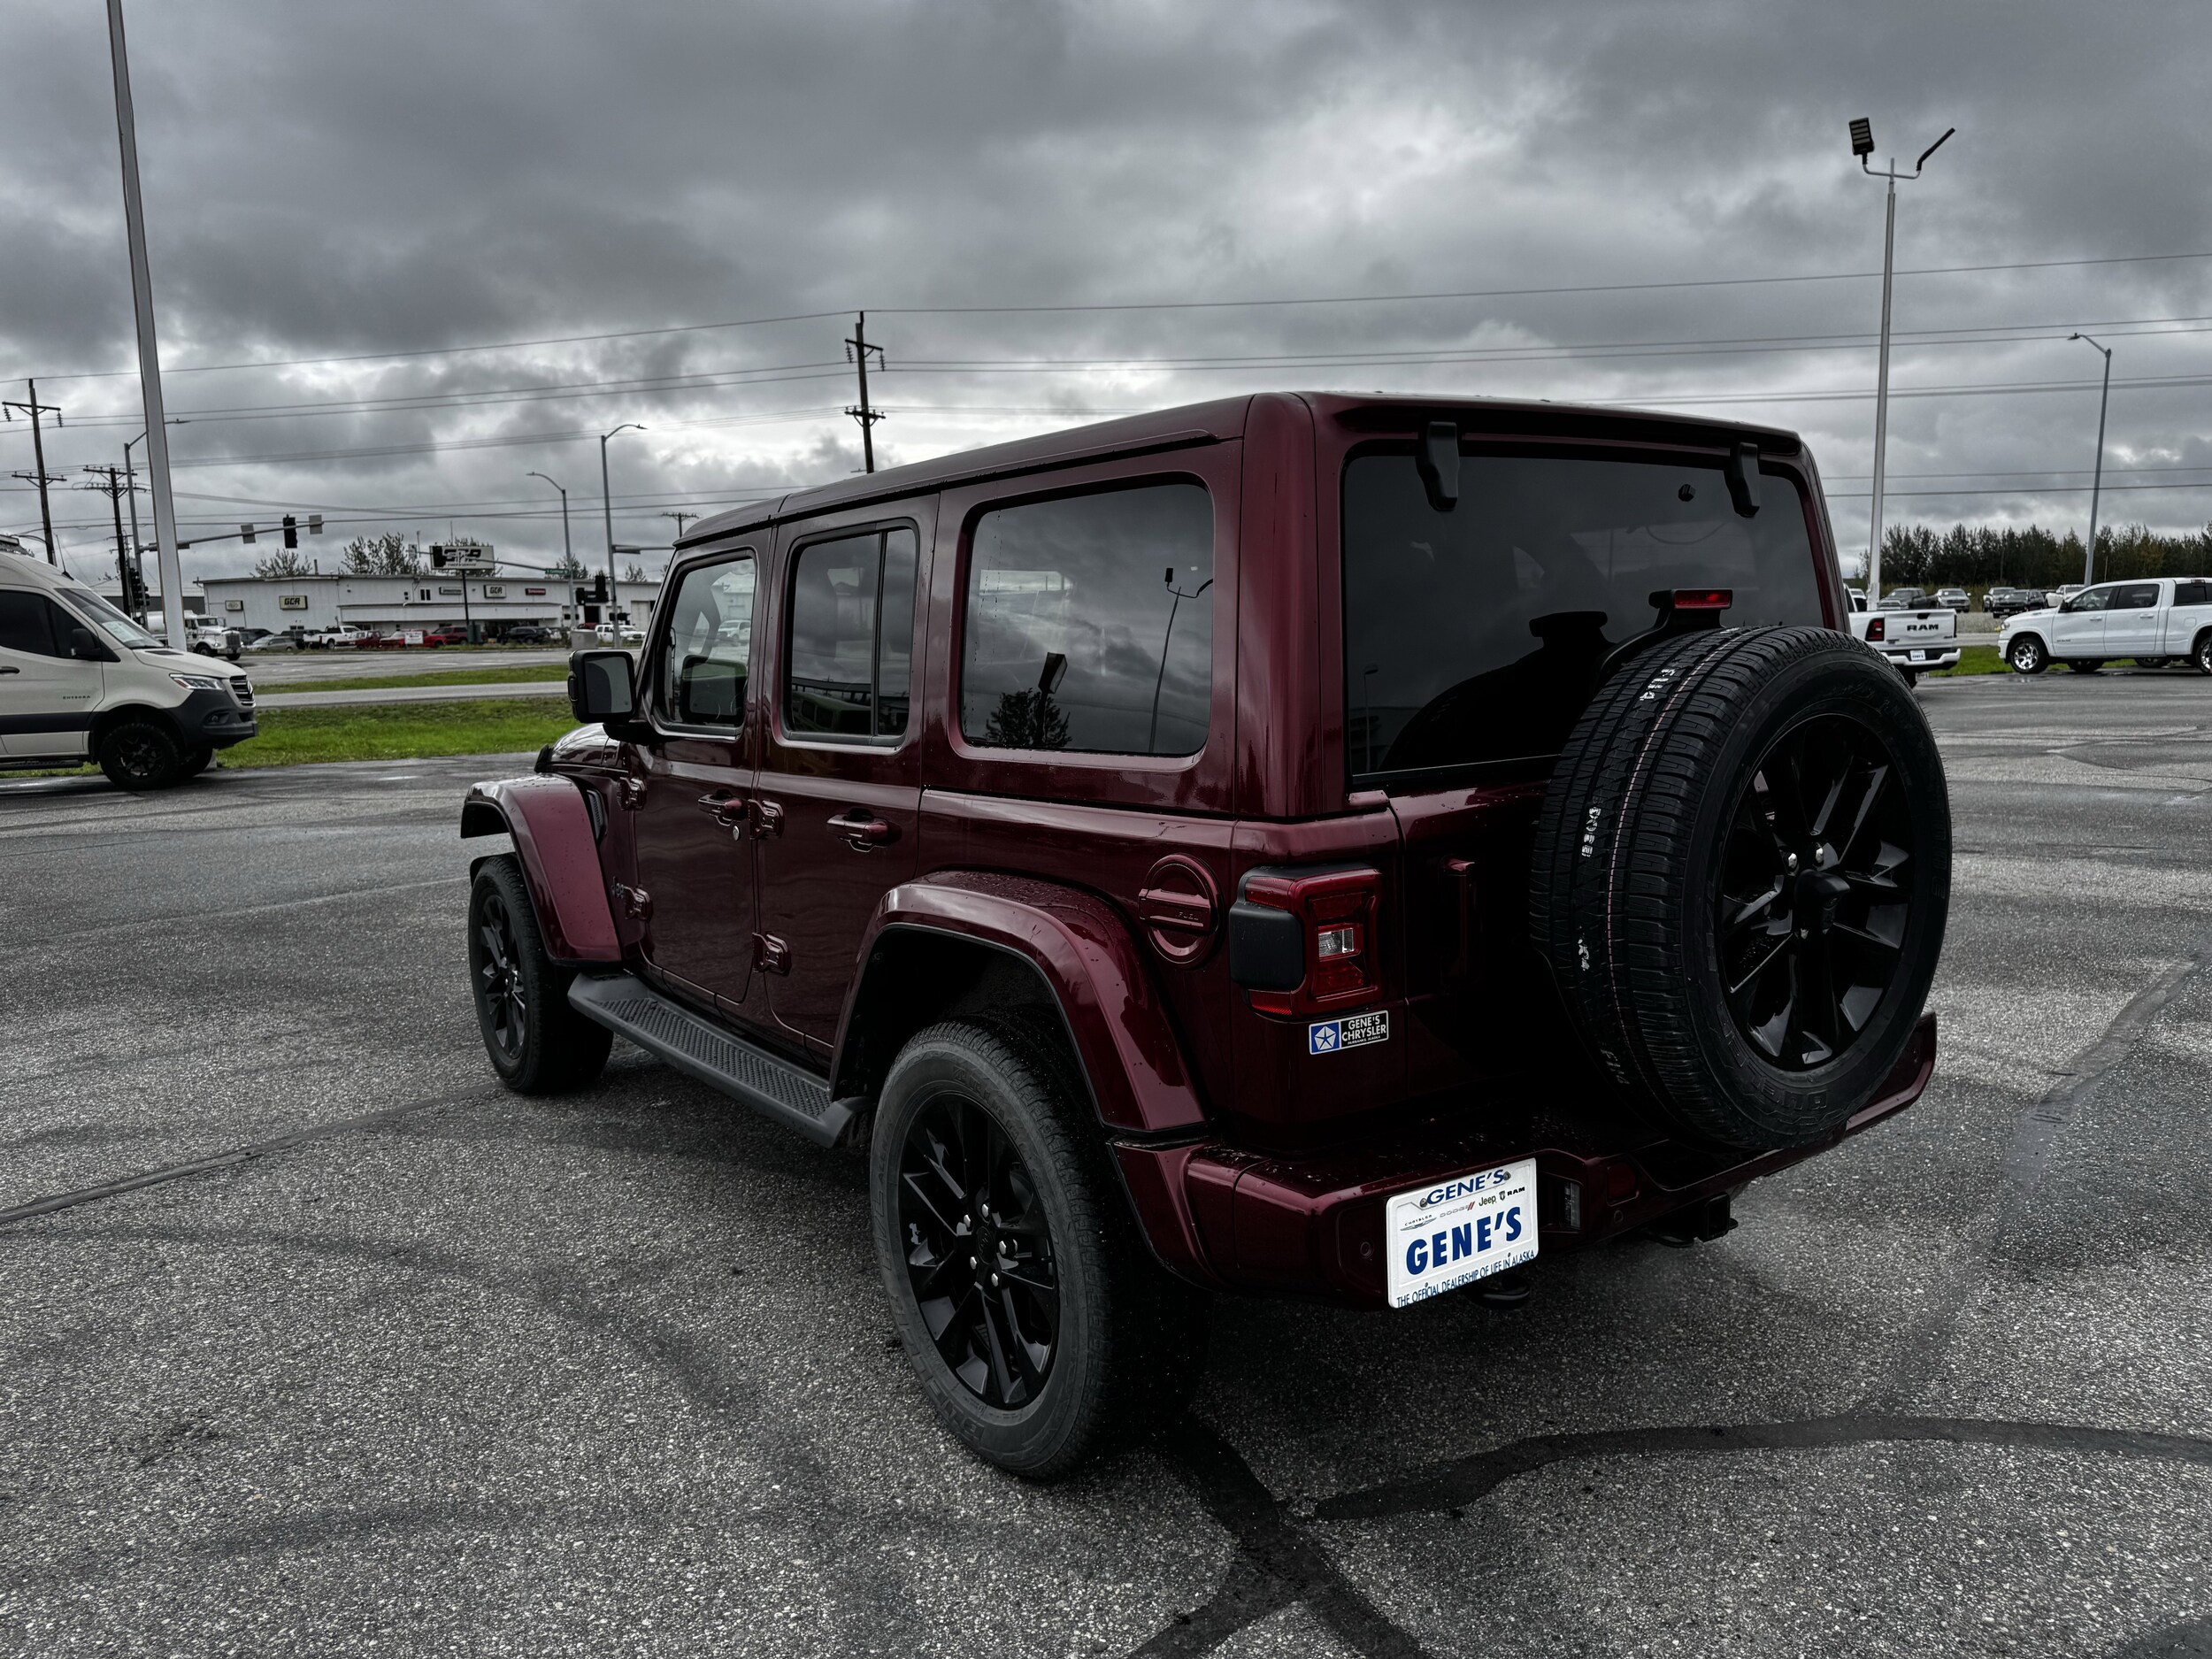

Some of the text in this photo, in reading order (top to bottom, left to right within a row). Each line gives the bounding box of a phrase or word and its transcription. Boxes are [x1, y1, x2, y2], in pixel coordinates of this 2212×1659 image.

[1341, 1024, 1386, 1041] CHRYSLER
[1348, 1015, 1380, 1030] GENE'S
[1425, 1169, 1504, 1205] GENE'S
[1404, 1214, 1432, 1226] CHRYSLER
[1479, 1195, 1496, 1207] Jeep
[1507, 1187, 1525, 1196] RAM
[1406, 1206, 1522, 1276] GENE'S
[1396, 1249, 1535, 1308] THE OFFICIAL DEALERSHIP OF LIFE IN ALASKA
